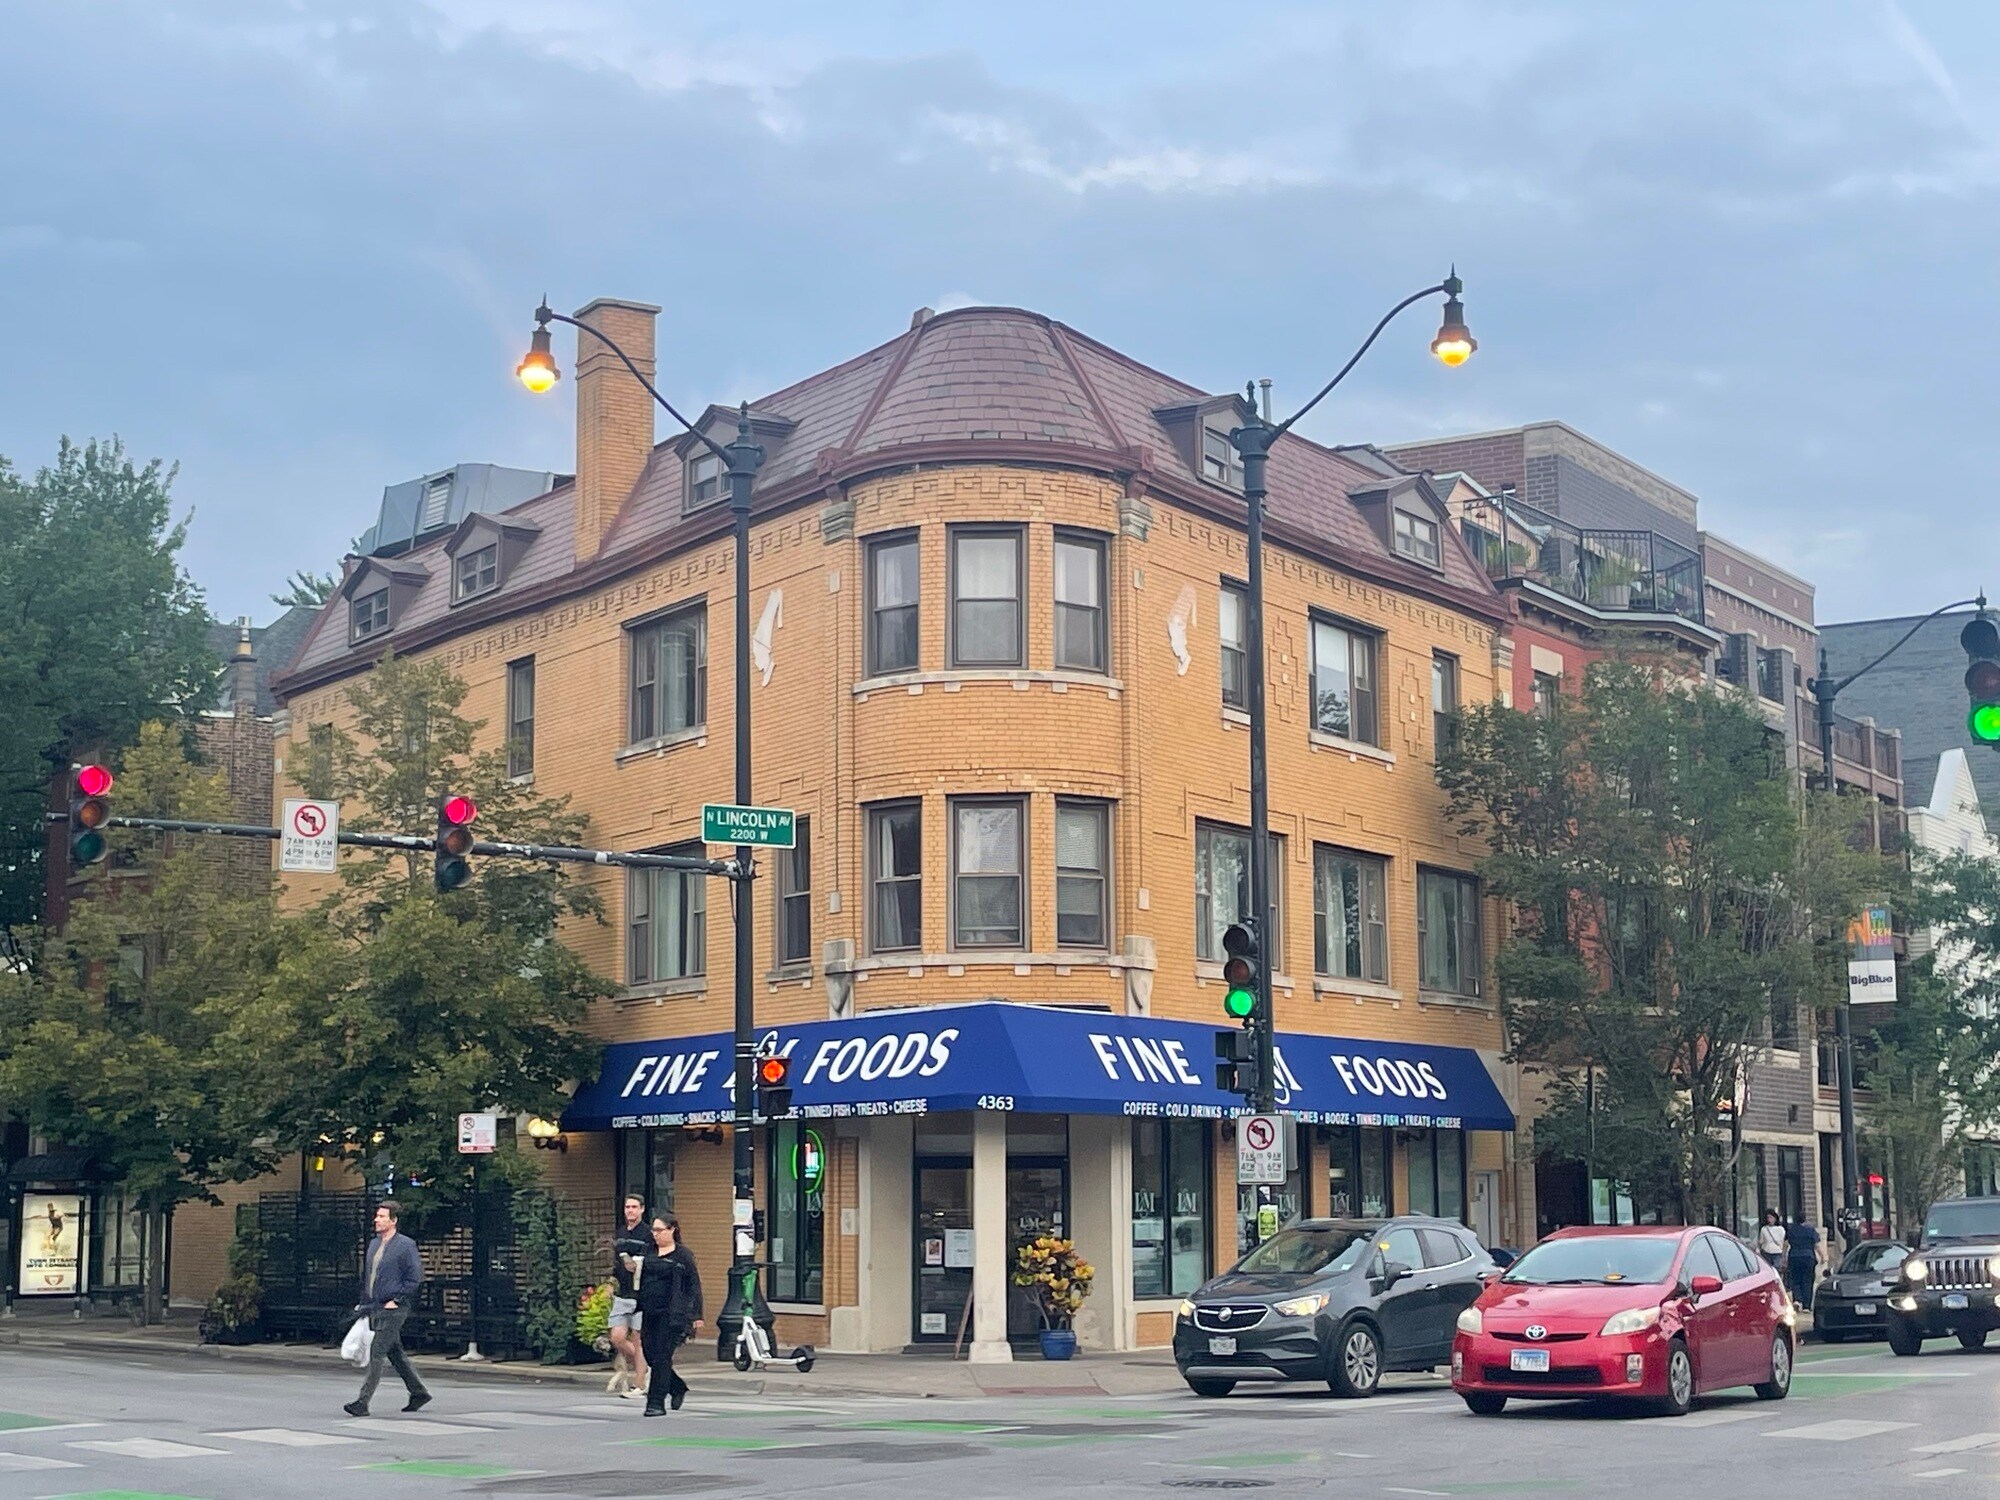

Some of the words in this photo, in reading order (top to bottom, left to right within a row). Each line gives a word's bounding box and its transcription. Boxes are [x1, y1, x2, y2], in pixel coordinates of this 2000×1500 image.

[706, 811, 714, 822] N
[717, 810, 777, 828] LINCOLN
[779, 815, 791, 826] AV
[730, 828, 756, 840] 2200
[760, 830, 769, 841] W
[1850, 975, 1893, 987] BigBlue
[802, 1028, 960, 1085] FOODS
[1088, 1033, 1202, 1085] FINE
[620, 1050, 720, 1098] FINE
[1330, 1055, 1447, 1100] FOODS
[804, 1104, 831, 1119] TINNED
[832, 1103, 852, 1117] FISH
[856, 1101, 888, 1116] TREATS
[893, 1098, 928, 1114] CHEESE
[977, 1094, 1014, 1111] 4363
[612, 1115, 638, 1128] COFFEE
[641, 1114, 659, 1127] COLD
[659, 1113, 684, 1126] DRINKS
[688, 1111, 716, 1124] SNACKS
[1123, 1101, 1158, 1116] COFFEE
[1165, 1102, 1189, 1117] COLD
[1191, 1104, 1222, 1119] DRINKS
[1229, 1106, 1256, 1119] SNACK
[1325, 1112, 1350, 1125] BOOZE
[1356, 1113, 1382, 1126] TINNED
[1383, 1114, 1399, 1126] FISH
[1405, 1114, 1431, 1128] TREATS
[1436, 1116, 1462, 1129] CHEESE
